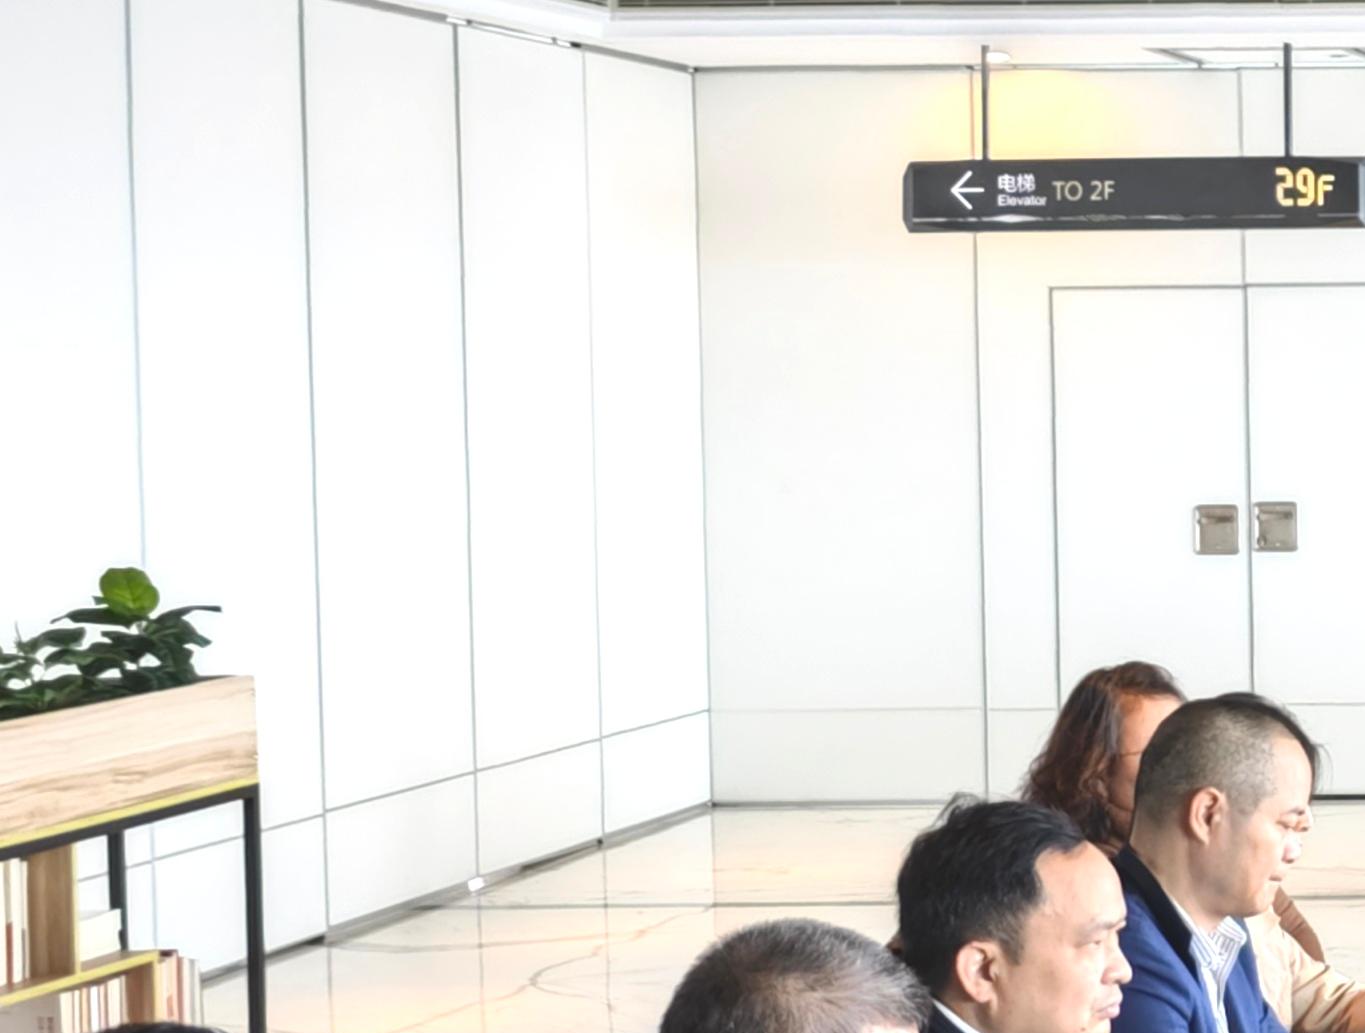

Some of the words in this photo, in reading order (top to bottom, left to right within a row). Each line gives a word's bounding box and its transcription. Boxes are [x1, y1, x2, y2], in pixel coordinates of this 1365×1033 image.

[997, 172, 1036, 193] 电梯
[1052, 180, 1083, 201] TO
[1090, 180, 1115, 201] 2F
[1275, 167, 1336, 207] 29F
[997, 194, 1047, 206] Elevator
